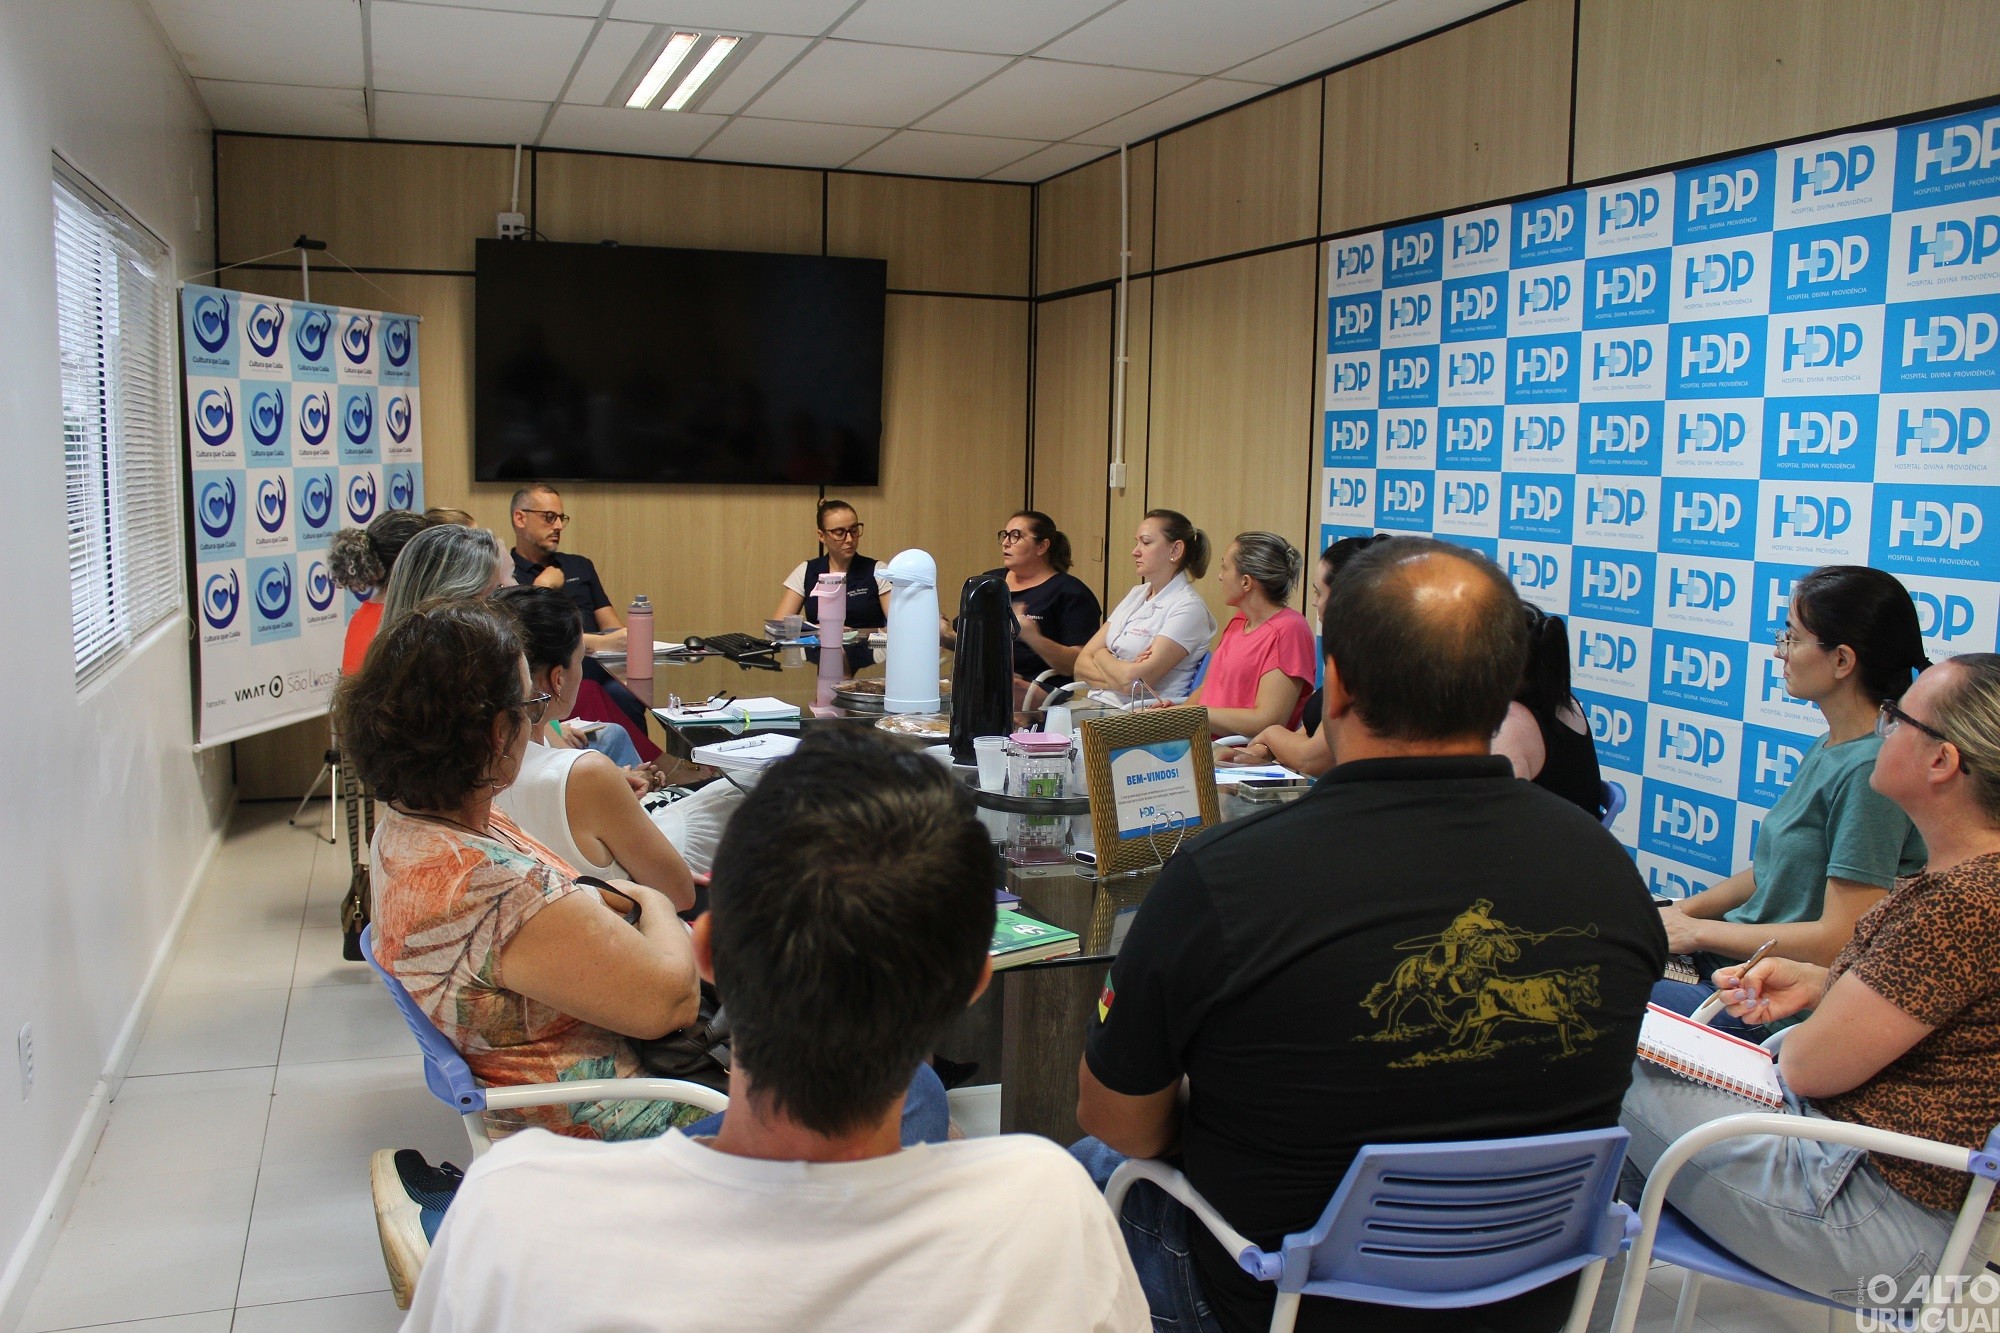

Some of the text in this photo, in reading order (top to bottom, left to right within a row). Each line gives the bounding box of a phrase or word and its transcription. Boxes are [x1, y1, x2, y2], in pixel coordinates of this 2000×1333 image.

[1688, 168, 1759, 222] HDP
[1792, 144, 1874, 204] HDP
[1914, 185, 1941, 195] HOSPITAL
[1944, 182, 1965, 190] DIVINA
[1520, 203, 1574, 249] HDP
[1598, 186, 1659, 236] HDP
[1791, 206, 1814, 215] HOSPITAL
[1816, 203, 1834, 211] DIVINA
[1391, 231, 1433, 271] HDP
[1452, 217, 1499, 260] HDP
[1336, 243, 1374, 280] HDP
[1684, 249, 1754, 299] HDP
[1787, 234, 1869, 289] HDP
[1907, 278, 1935, 286] HOSPITAL
[1450, 285, 1497, 325] HDP
[1518, 274, 1571, 317] HDP
[1595, 263, 1656, 309] HDP
[1335, 302, 1372, 338] HDP
[1389, 293, 1431, 331] HDP
[1592, 338, 1653, 381] HDP
[1681, 331, 1750, 378] HDP
[1782, 322, 1864, 373] HDP
[1902, 312, 1998, 368] HDP
[1333, 360, 1370, 394] HDP
[1388, 356, 1429, 392] HDP
[1448, 350, 1495, 388] HDP
[1515, 345, 1568, 385] HDP
[1332, 420, 1369, 451] HDP
[1386, 418, 1427, 451] HDP
[1446, 417, 1492, 452] HDP
[1513, 415, 1565, 452] HDP
[1590, 414, 1650, 454] HDP
[1677, 412, 1746, 455] HDP
[1778, 410, 1858, 457] HDP
[1895, 407, 1991, 457] HDP
[1329, 477, 1366, 508] HDP
[1383, 479, 1424, 512] HDP
[1443, 481, 1489, 516] HDP
[1510, 484, 1562, 522] HDP
[1586, 487, 1645, 527] HDP
[1672, 491, 1741, 534] HDP
[1772, 494, 1852, 541] HDP
[1889, 500, 1983, 550] HDP
[1507, 551, 1558, 590] HDP
[1582, 559, 1641, 601] HDP
[1668, 567, 1736, 612] HDP
[1909, 591, 1974, 641] DP
[1578, 629, 1637, 674] HDP
[1663, 643, 1731, 692] HDP
[1659, 718, 1725, 768] HDP
[1755, 740, 1804, 786] HD
[1126, 768, 1179, 785] BEM-VINDOS!
[1653, 793, 1719, 846] HDP
